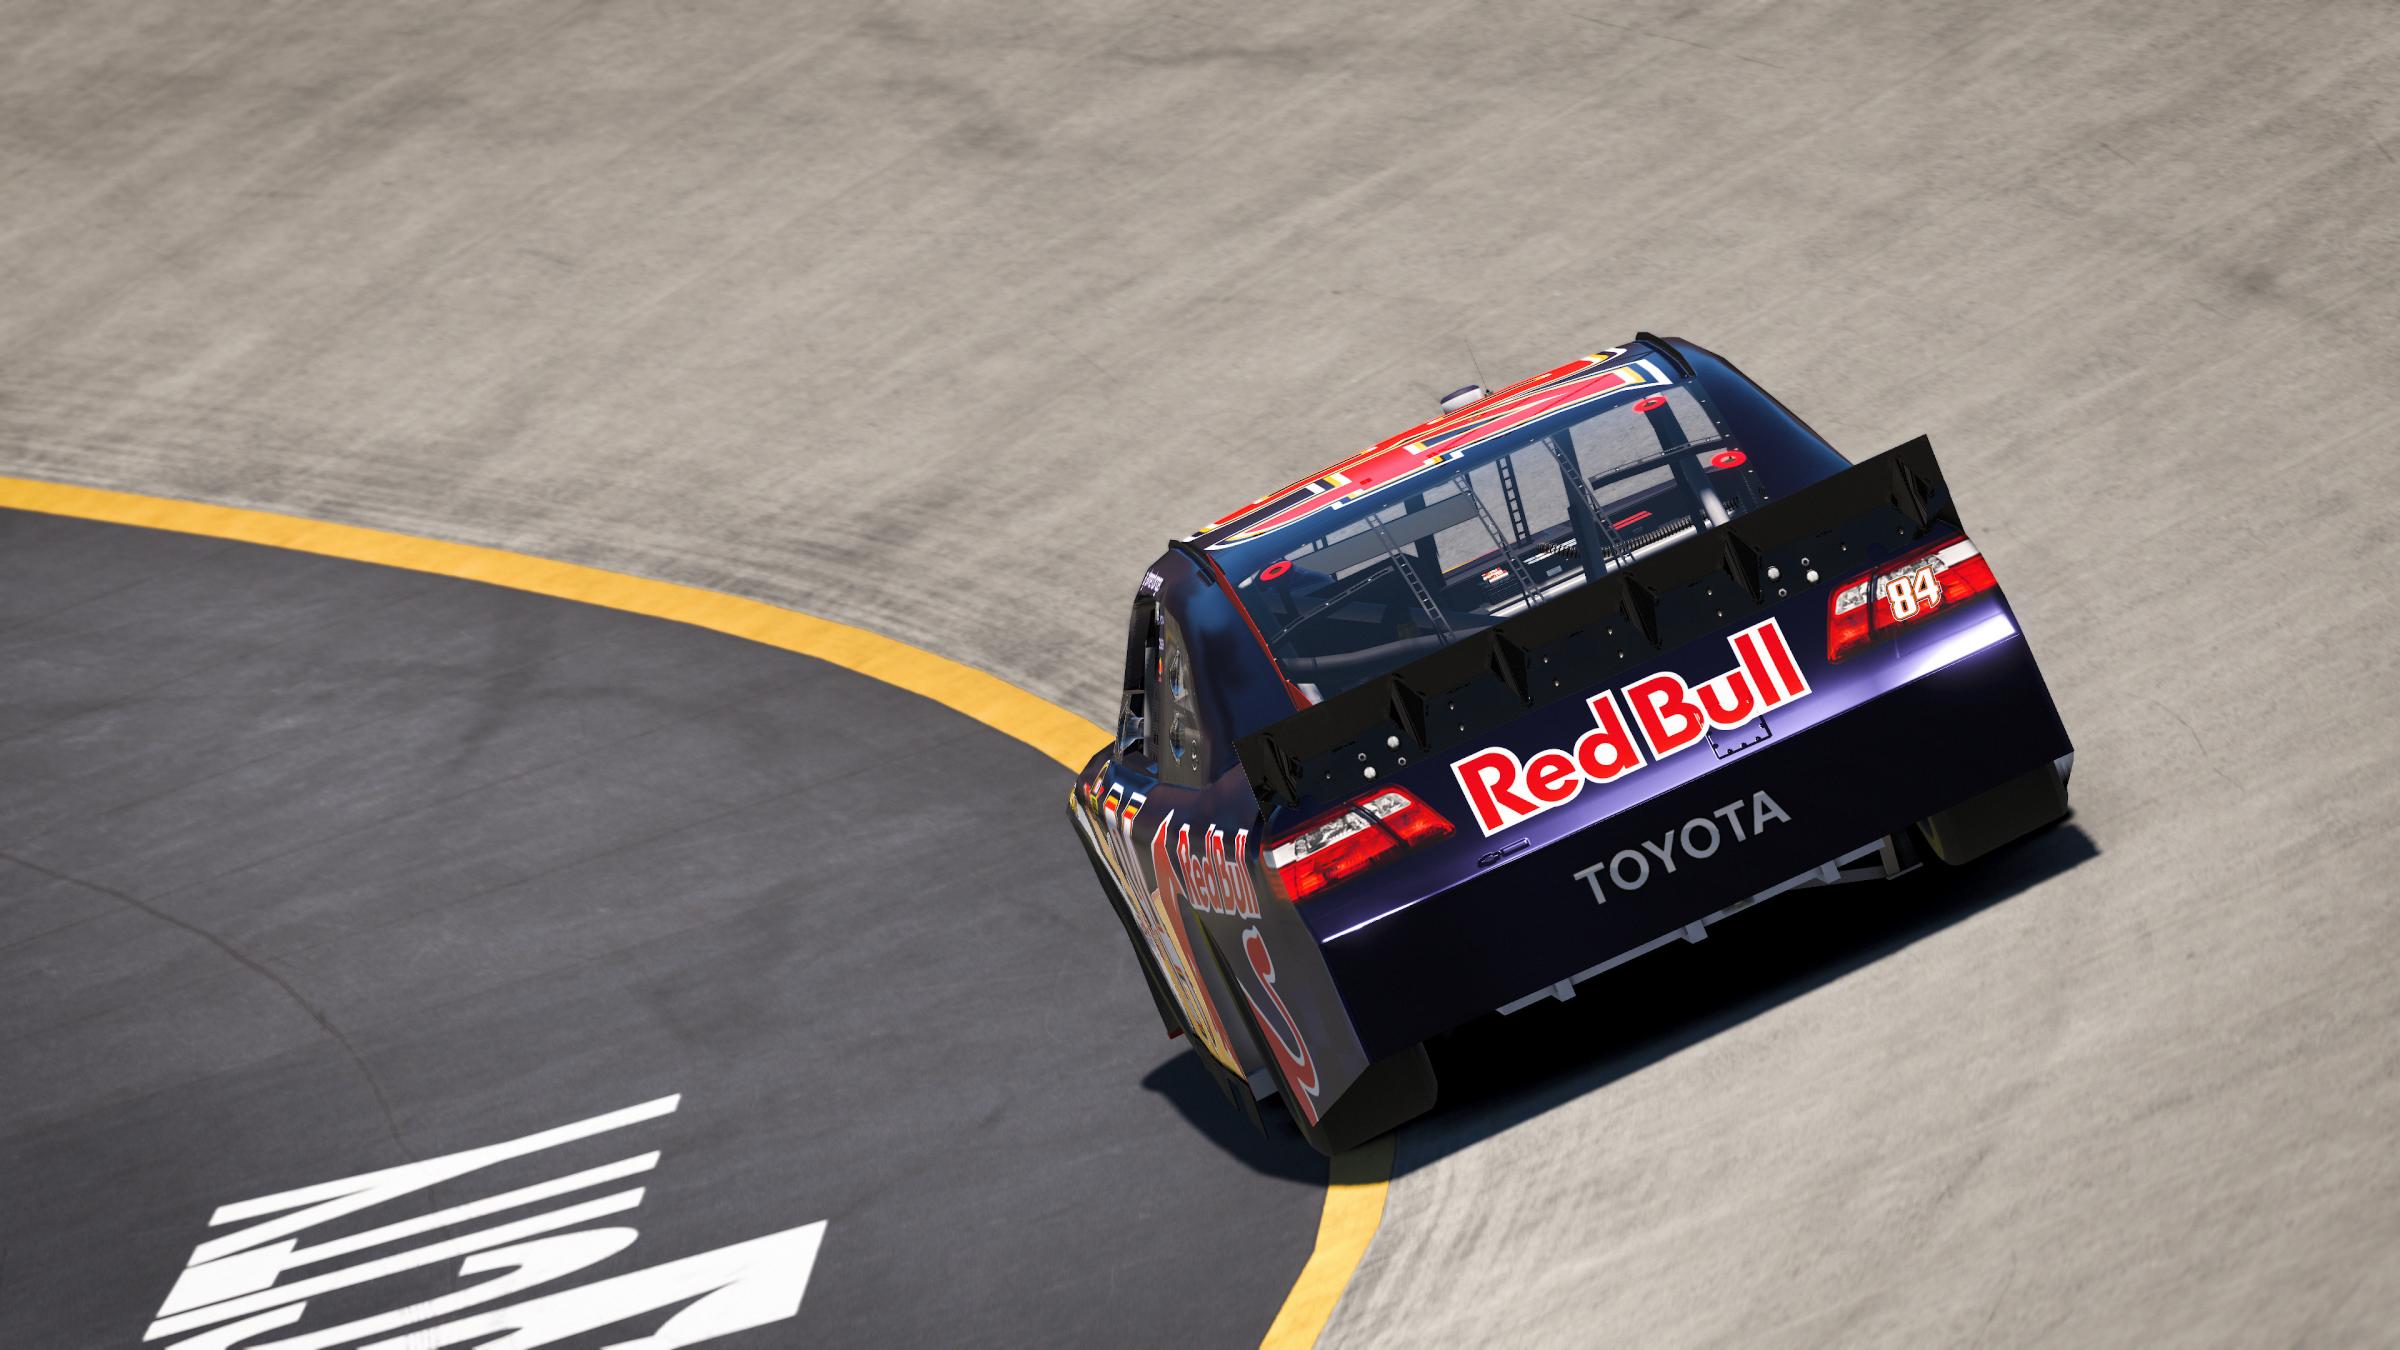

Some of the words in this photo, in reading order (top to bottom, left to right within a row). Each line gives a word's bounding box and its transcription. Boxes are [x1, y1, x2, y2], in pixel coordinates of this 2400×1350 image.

[1886, 564, 1942, 621] 84
[1450, 688, 1648, 838] Red
[1620, 615, 1813, 761] Bull
[1176, 822, 1225, 914] Red
[1211, 827, 1263, 920] Bull
[1573, 788, 1791, 905] TOYOTA
